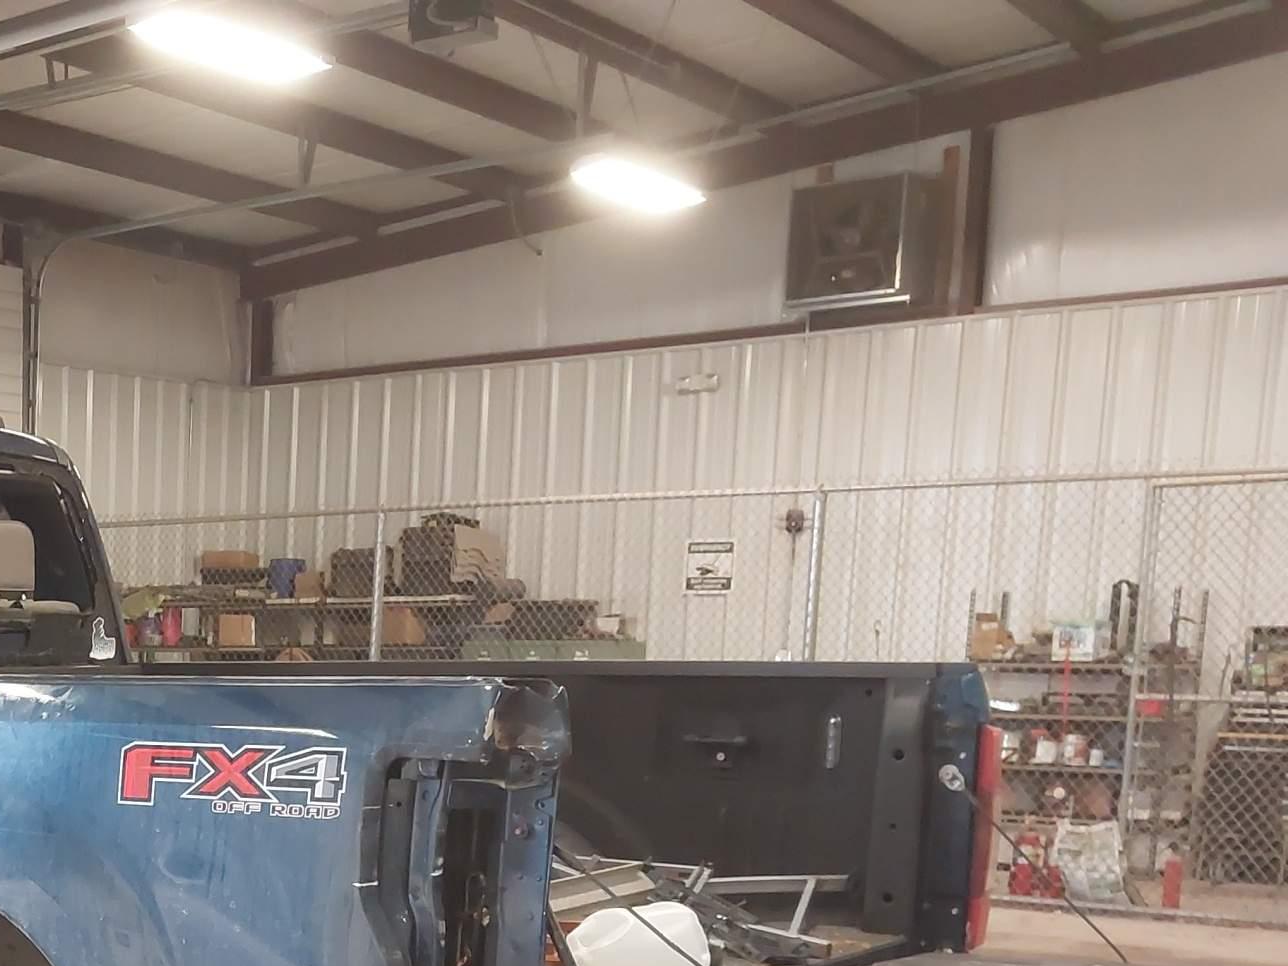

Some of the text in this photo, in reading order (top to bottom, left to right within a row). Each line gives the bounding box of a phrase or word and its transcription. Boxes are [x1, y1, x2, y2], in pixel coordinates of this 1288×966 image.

[117, 741, 347, 806] FX4
[211, 800, 340, 819] OFF ROAD
